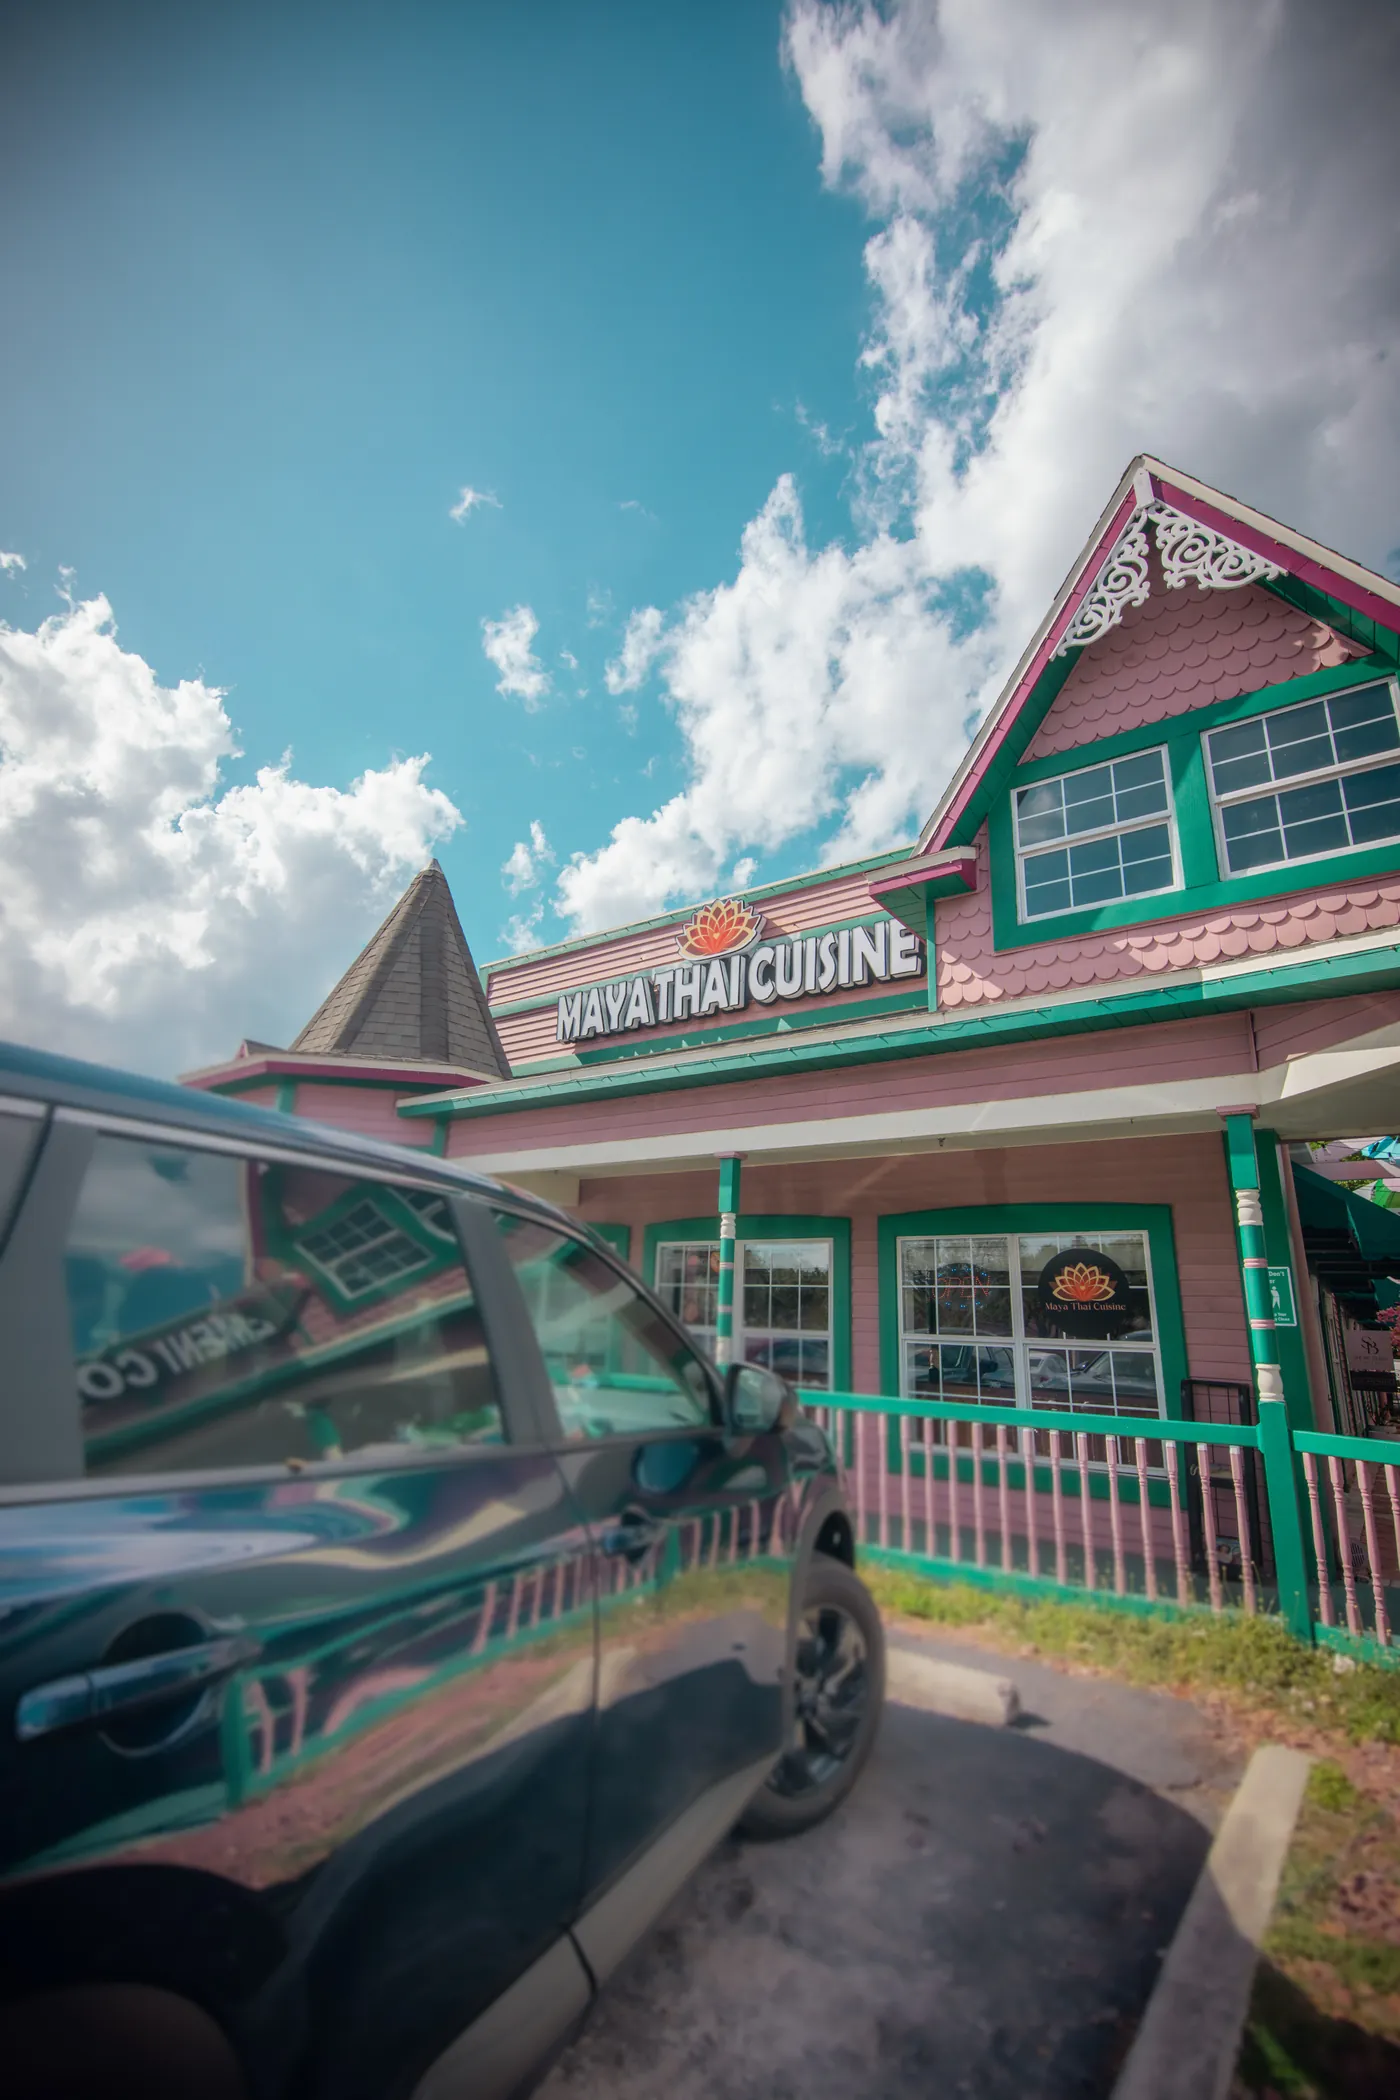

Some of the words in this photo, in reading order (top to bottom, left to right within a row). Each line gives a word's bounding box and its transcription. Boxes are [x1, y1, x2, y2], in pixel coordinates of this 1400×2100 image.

[556, 977, 653, 1042] MAYA
[653, 955, 746, 1022] THAI
[747, 919, 922, 1002] CUISINE
[931, 1275, 991, 1299] OPEN
[1045, 1302, 1069, 1313] Maya
[1070, 1302, 1092, 1311] Thai
[1093, 1302, 1127, 1311] Cuisine
